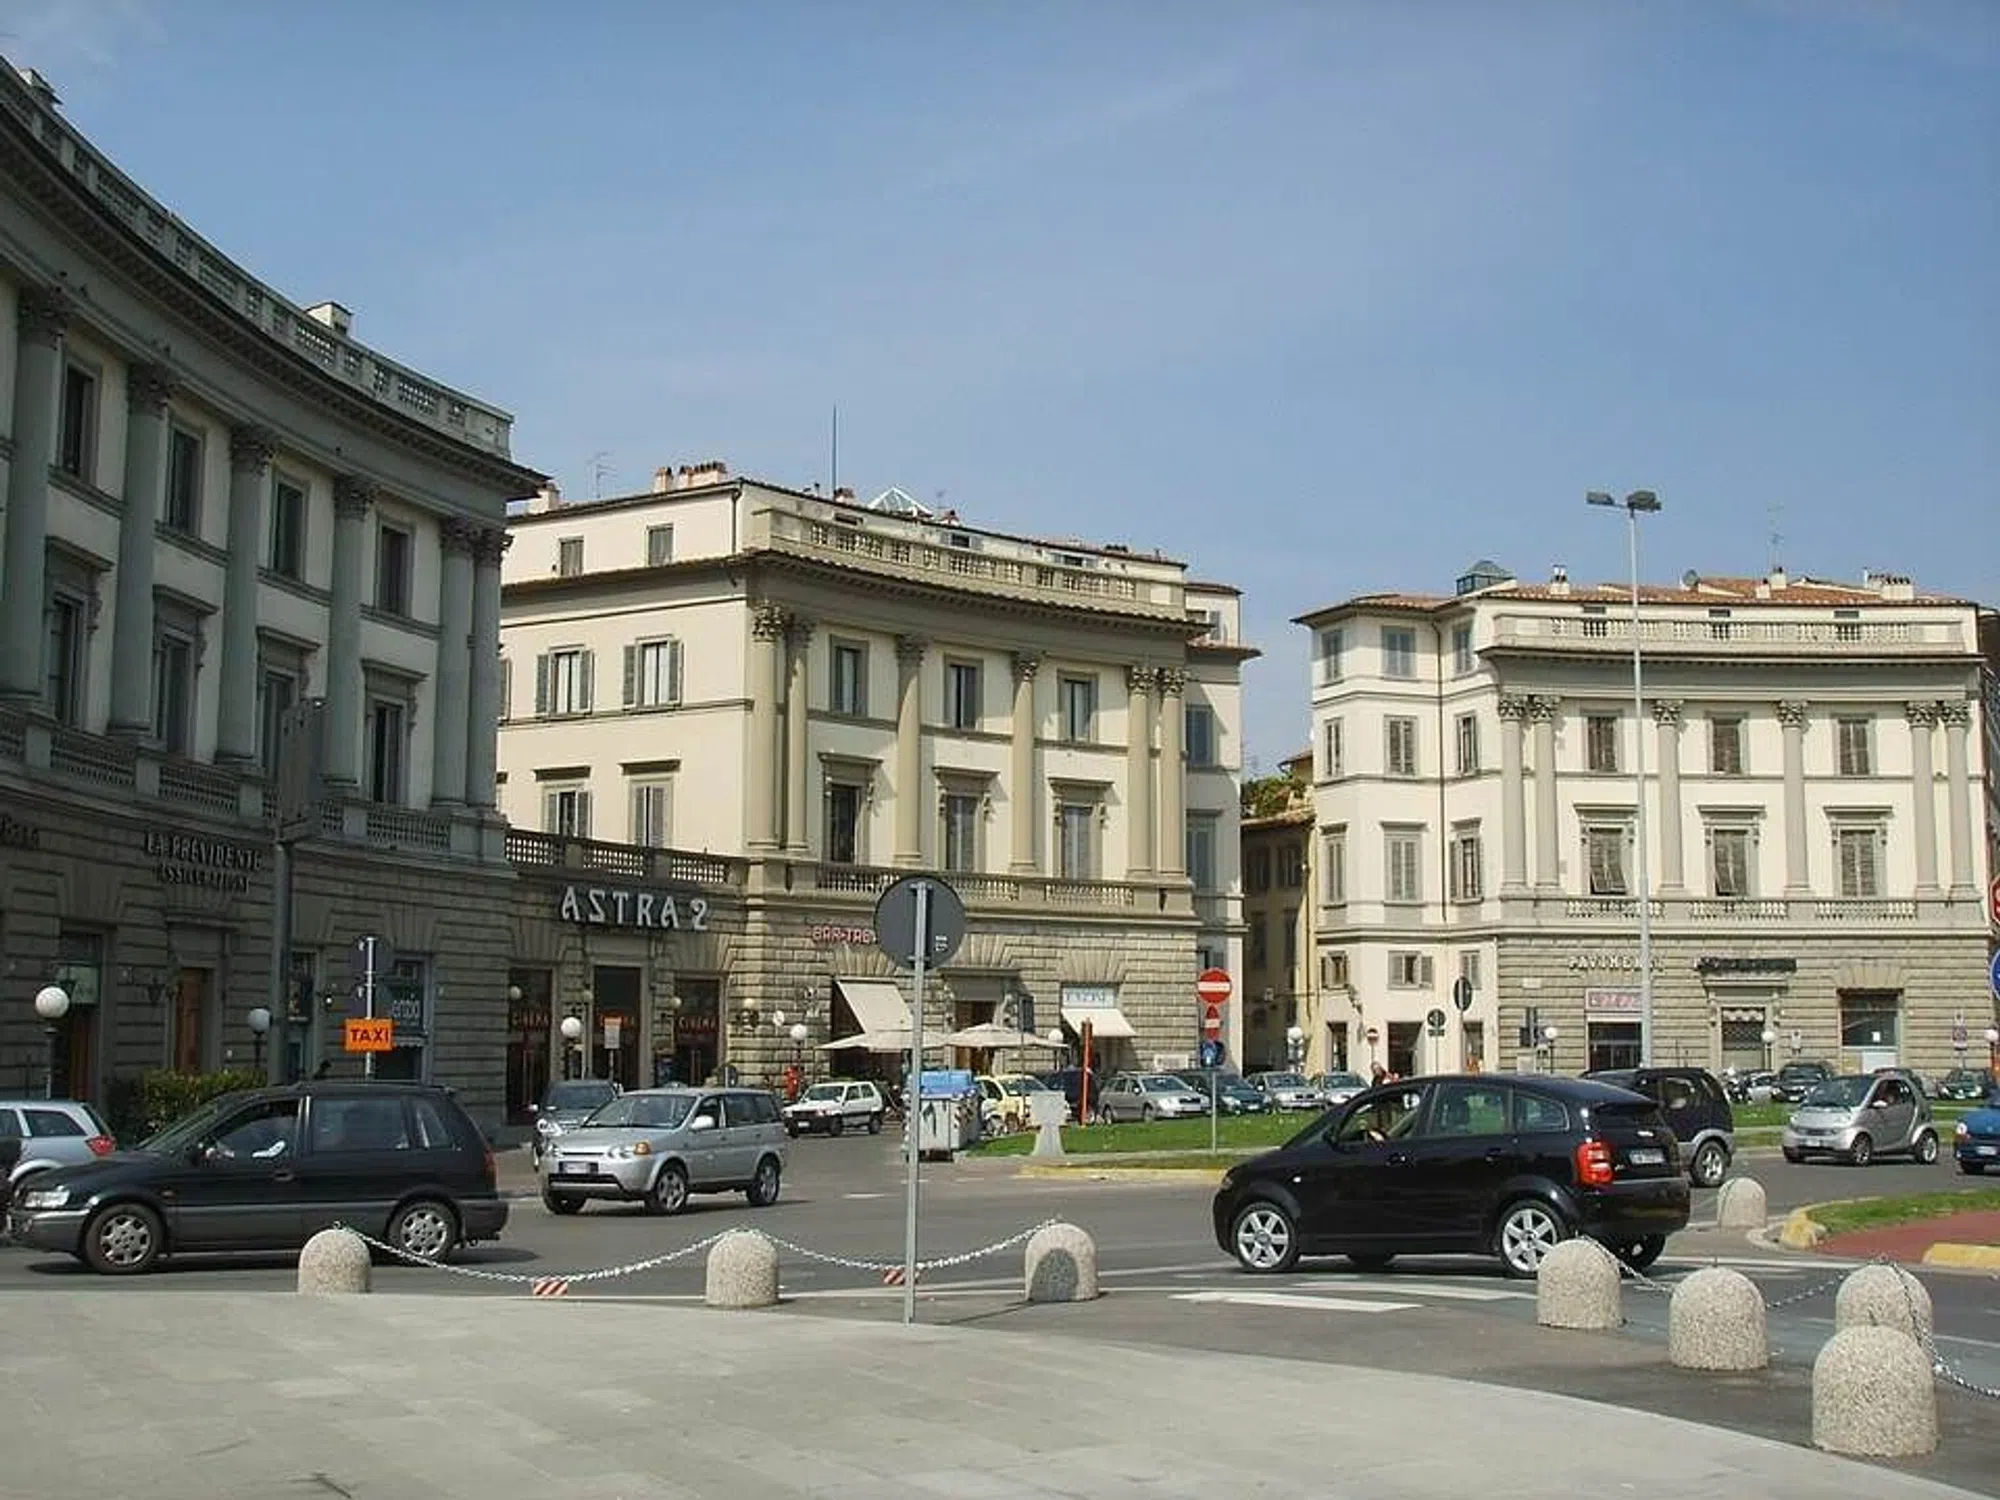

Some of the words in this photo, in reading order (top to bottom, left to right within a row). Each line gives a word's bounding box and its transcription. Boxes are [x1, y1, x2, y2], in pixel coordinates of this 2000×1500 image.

[562, 886, 679, 928] ASTRA
[691, 899, 708, 930] 2
[351, 1028, 390, 1044] TAXI
